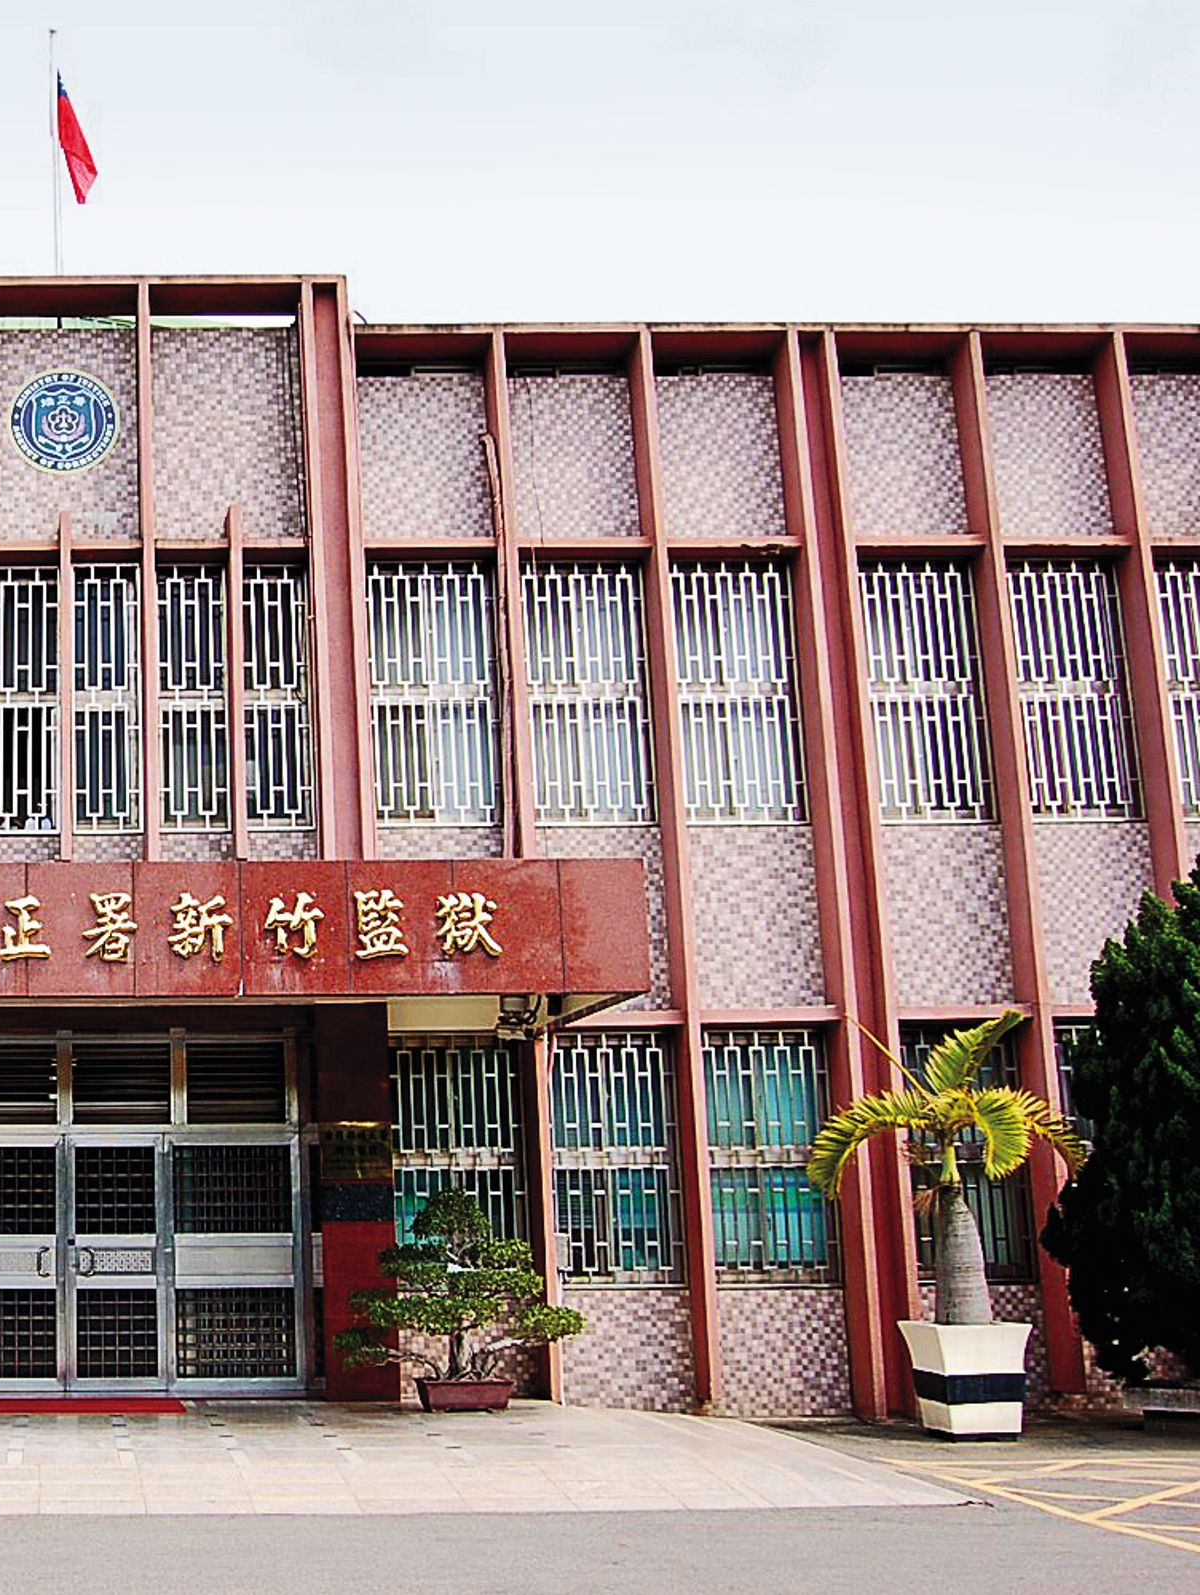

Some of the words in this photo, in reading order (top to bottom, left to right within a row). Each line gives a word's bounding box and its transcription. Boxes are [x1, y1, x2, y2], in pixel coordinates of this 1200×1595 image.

[16, 374, 59, 408] MINISTRY
[77, 377, 111, 407] JUSTICE
[39, 459, 55, 467] OF
